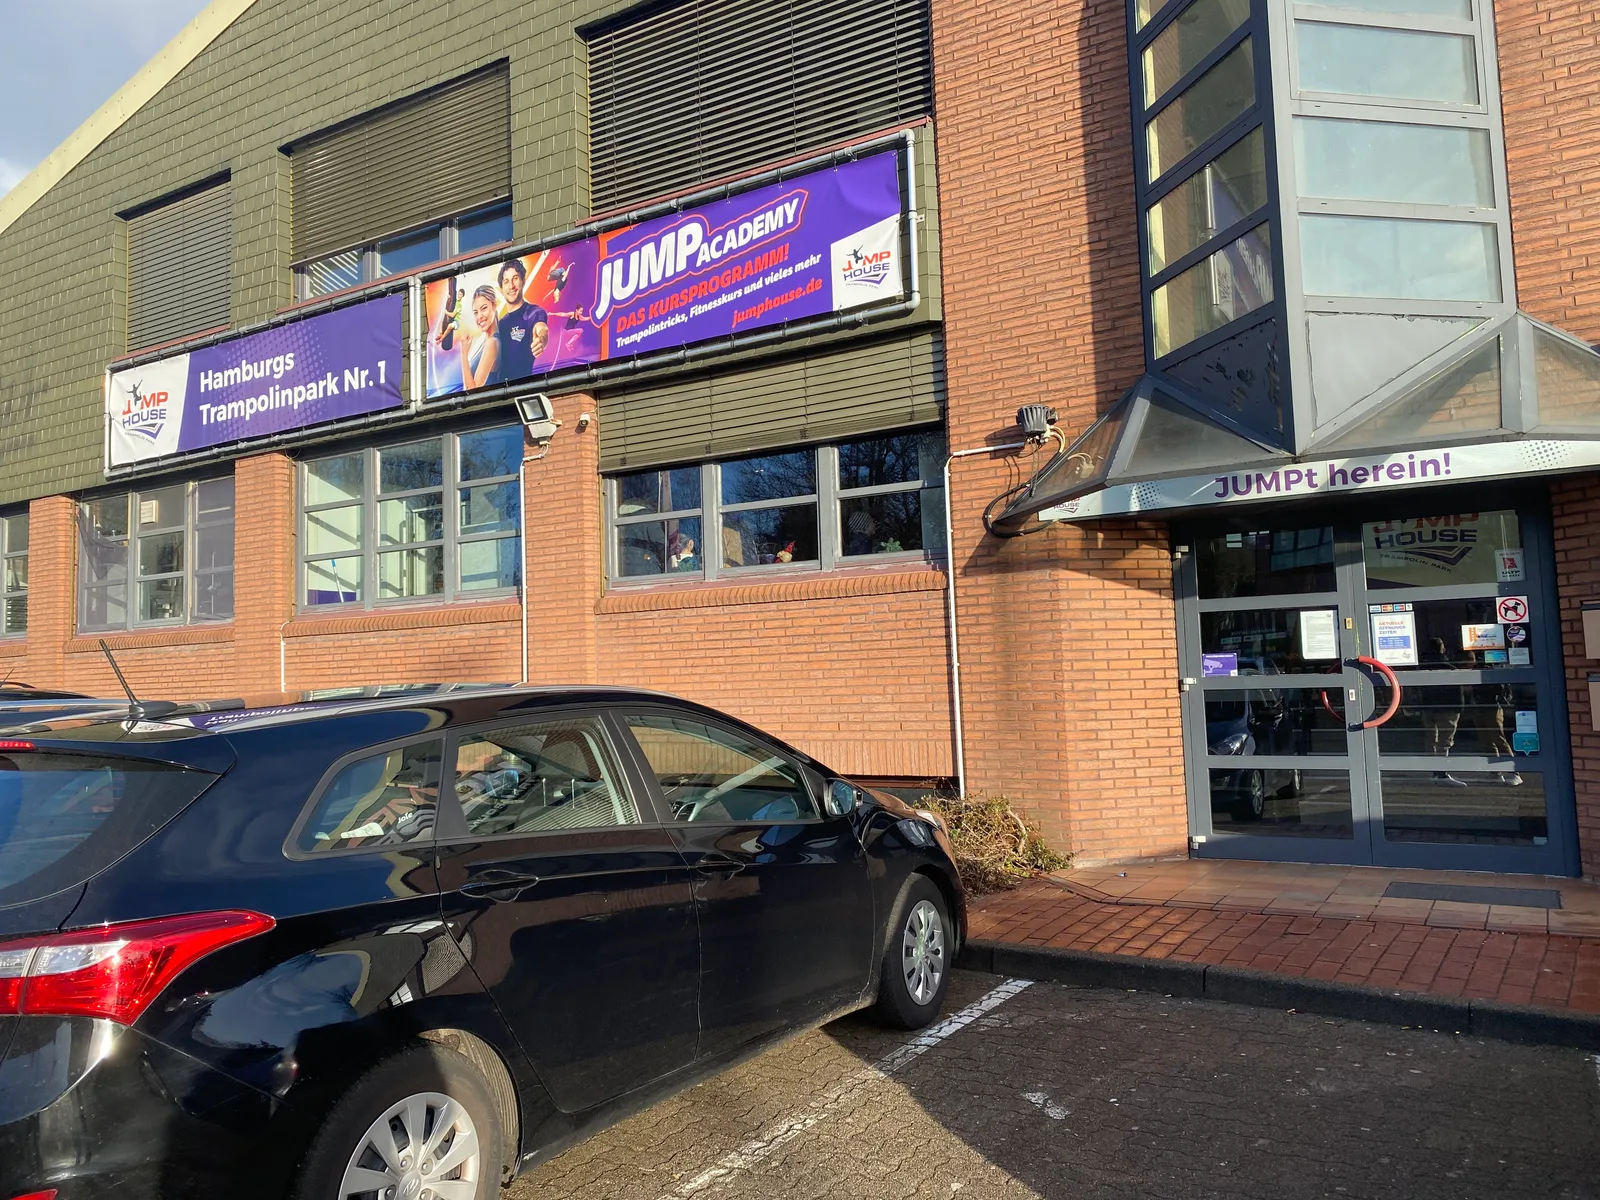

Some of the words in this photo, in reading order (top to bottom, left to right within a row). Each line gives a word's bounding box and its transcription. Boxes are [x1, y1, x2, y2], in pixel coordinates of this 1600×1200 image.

[594, 222, 703, 320] JUMP
[696, 198, 799, 268] ACADEMY
[843, 262, 890, 281] HOUSE
[616, 307, 646, 333] DAS
[648, 242, 790, 320] KURSPROGRAMM!
[616, 313, 688, 348] Trampolintricks,
[690, 287, 743, 318] Fitnesskurs
[743, 276, 764, 295] und
[764, 265, 794, 286] vieles
[794, 253, 822, 273] mehr
[731, 277, 823, 329] jumphouse.de
[199, 372, 340, 426] Trampolinpark
[343, 366, 374, 393] Nr.
[377, 360, 386, 384] 1
[200, 352, 295, 393] Hamburgs
[122, 408, 167, 429] HOUSE
[1214, 468, 1319, 498] JUMPt
[1328, 452, 1451, 487] herein!
[1374, 529, 1478, 549] HOUSE
[1379, 553, 1429, 566] TRAMPOLIN
[1431, 562, 1453, 573] PARK
